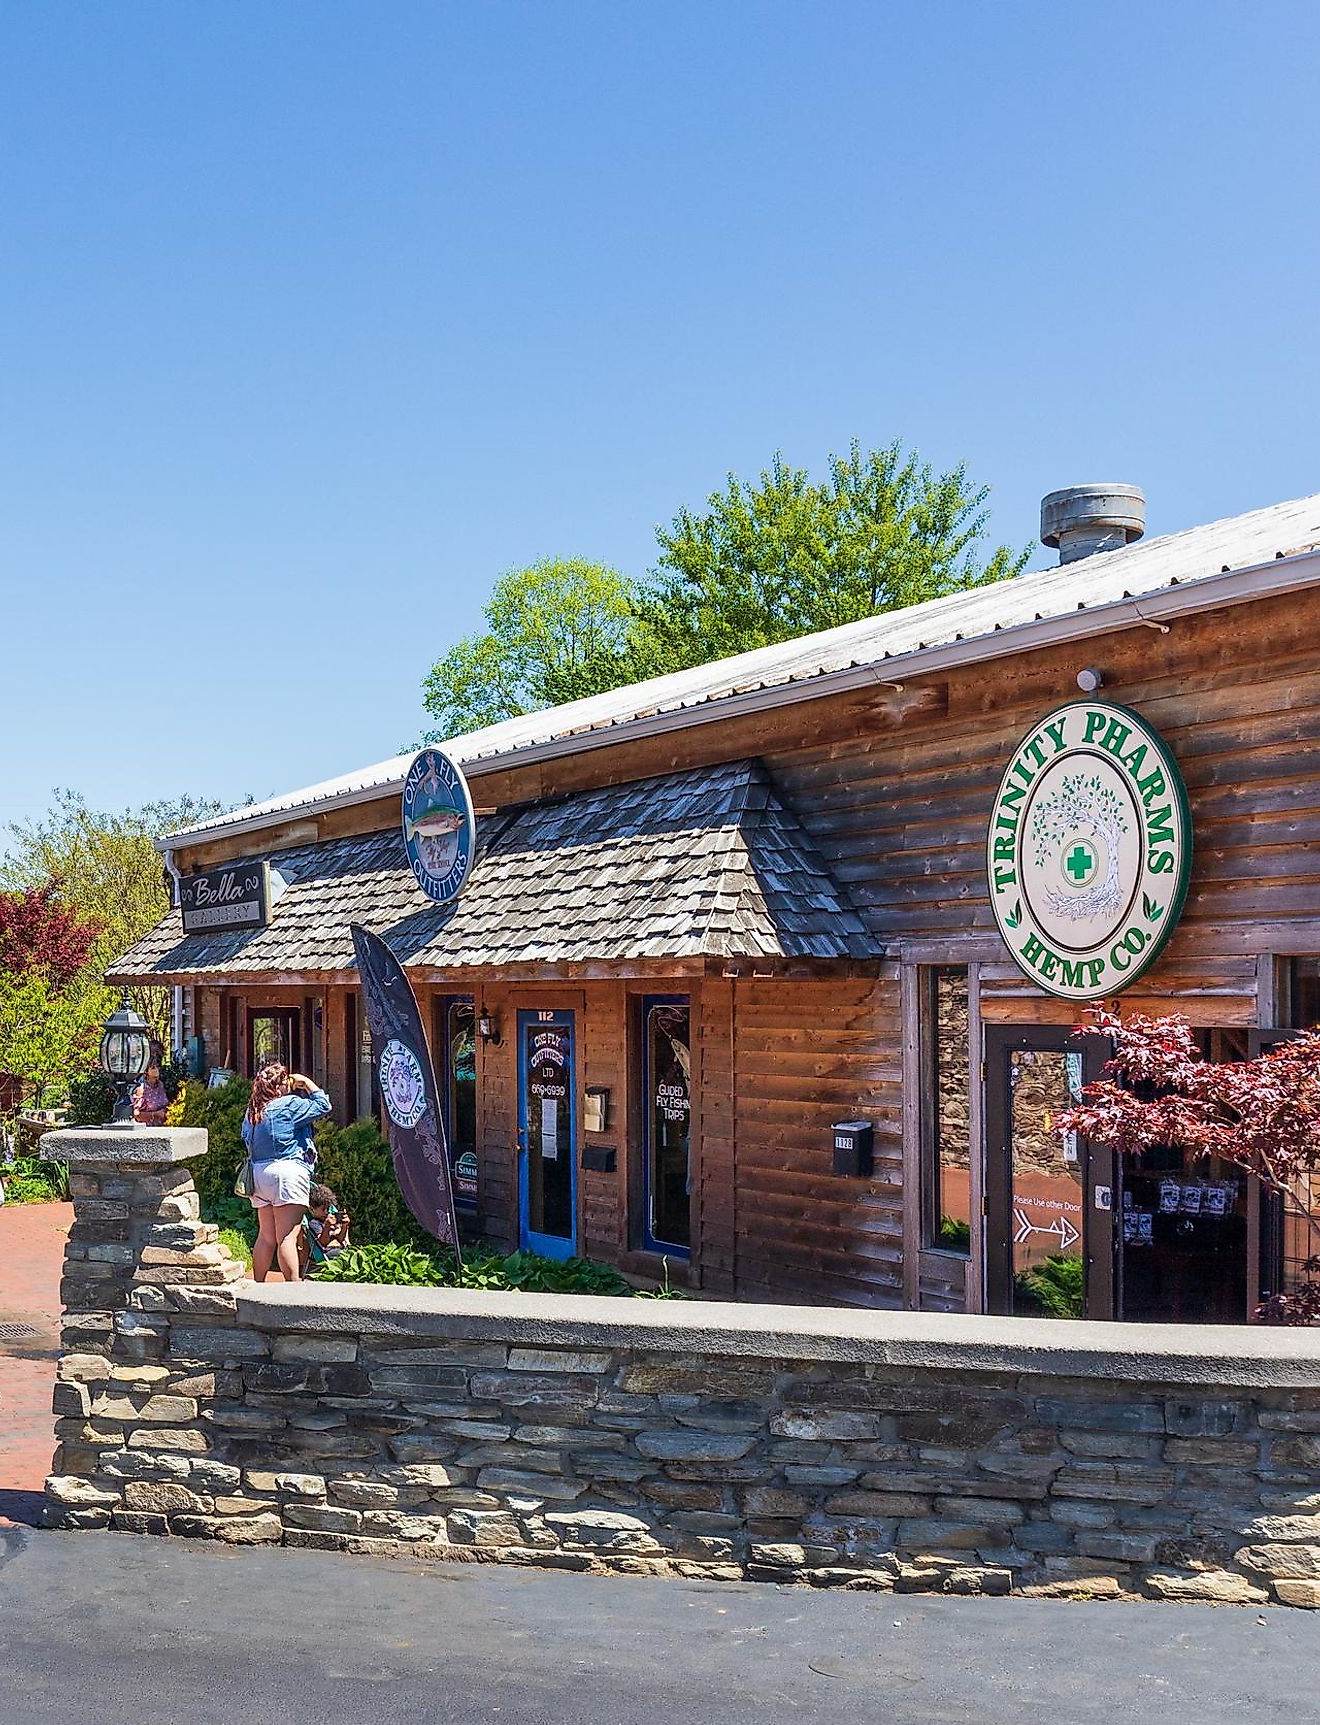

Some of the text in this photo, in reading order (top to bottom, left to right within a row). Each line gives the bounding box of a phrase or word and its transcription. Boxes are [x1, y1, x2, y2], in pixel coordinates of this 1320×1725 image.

[405, 758, 460, 805] ONE FLY
[994, 711, 1175, 895] TRINITY PHARMS
[413, 850, 467, 899] OUTFITTERS
[192, 872, 245, 906] Bella
[191, 905, 250, 925] GALLERY
[1020, 926, 1153, 988] HEMP CO.
[538, 1011, 554, 1021] 112
[534, 1033, 561, 1047] ONE FLY
[531, 1048, 564, 1068] OUTFITTERS
[542, 1067, 554, 1078] LTD
[658, 1083, 684, 1097] GUIDED
[656, 1095, 668, 1107] FLY
[663, 1108, 685, 1121] TRIPS
[458, 1164, 478, 1177] SIMM
[1013, 1195, 1082, 1212] Please Use other Door
